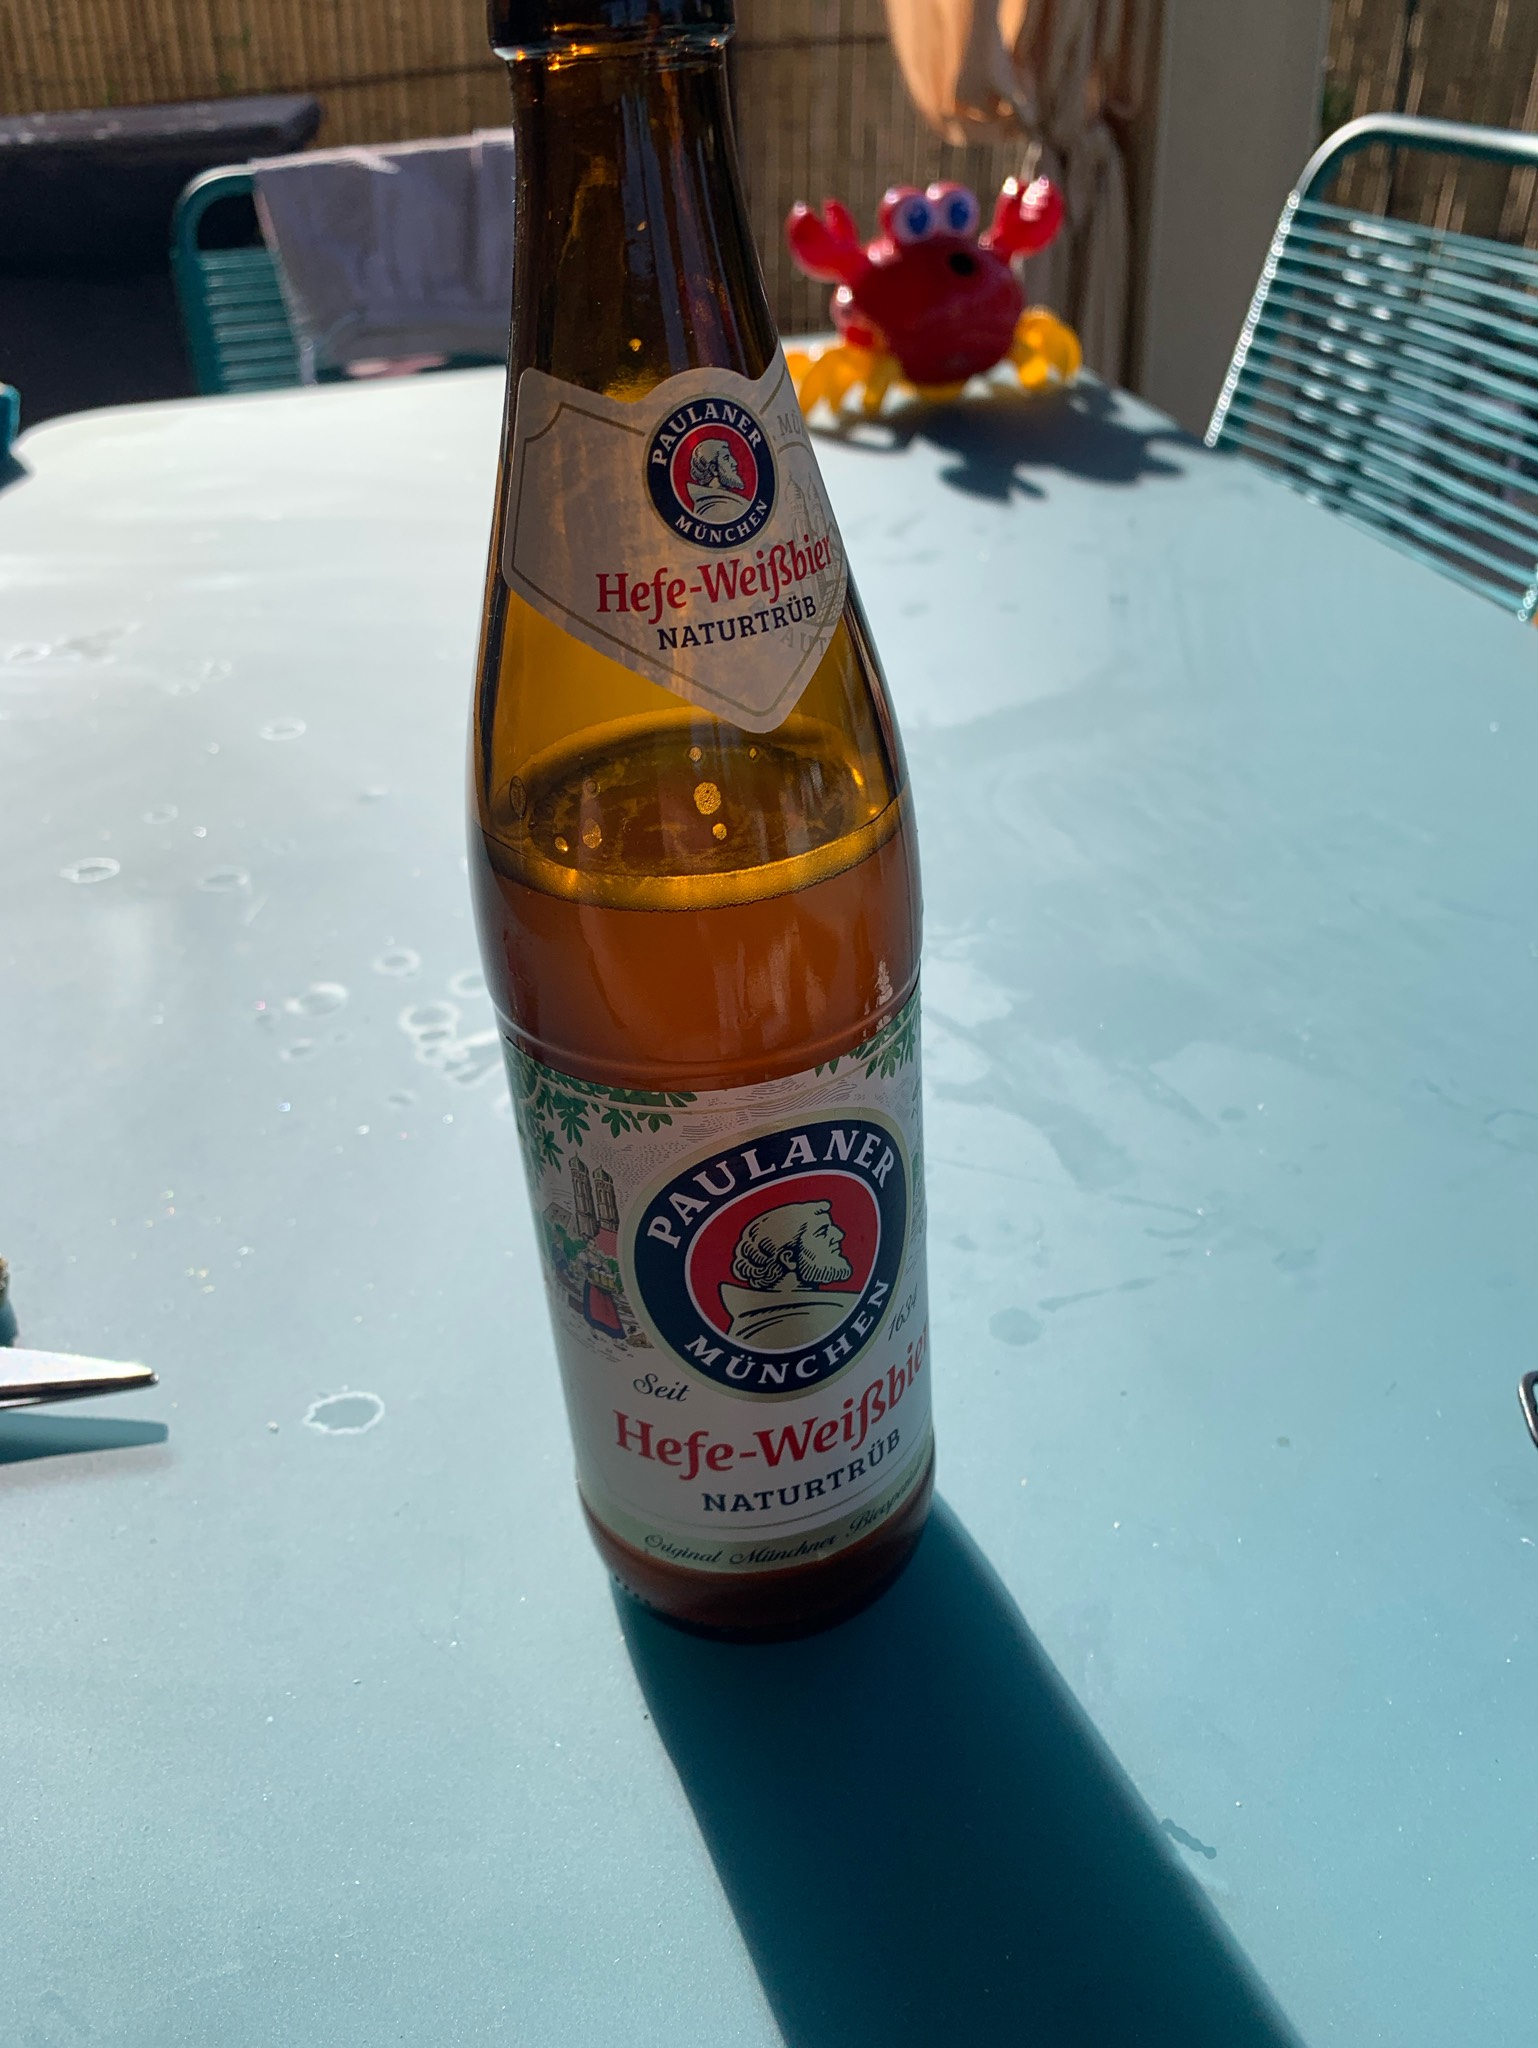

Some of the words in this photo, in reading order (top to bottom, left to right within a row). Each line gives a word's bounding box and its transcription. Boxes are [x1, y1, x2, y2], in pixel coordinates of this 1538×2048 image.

[651, 402, 763, 467] PAULANER
[674, 498, 769, 545] MÜNCHEN
[596, 533, 833, 626] Hefe-Weißbier
[657, 595, 818, 651] NATURTRÜB
[646, 1128, 896, 1250] PAULANER
[633, 1372, 692, 1403] Seit
[887, 1283, 918, 1342] 1634
[684, 1279, 891, 1385] MÜNCHEN
[702, 1427, 901, 1512] NATURTRÜB
[643, 1533, 723, 1564] Original
[729, 1534, 839, 1566] Münchner
